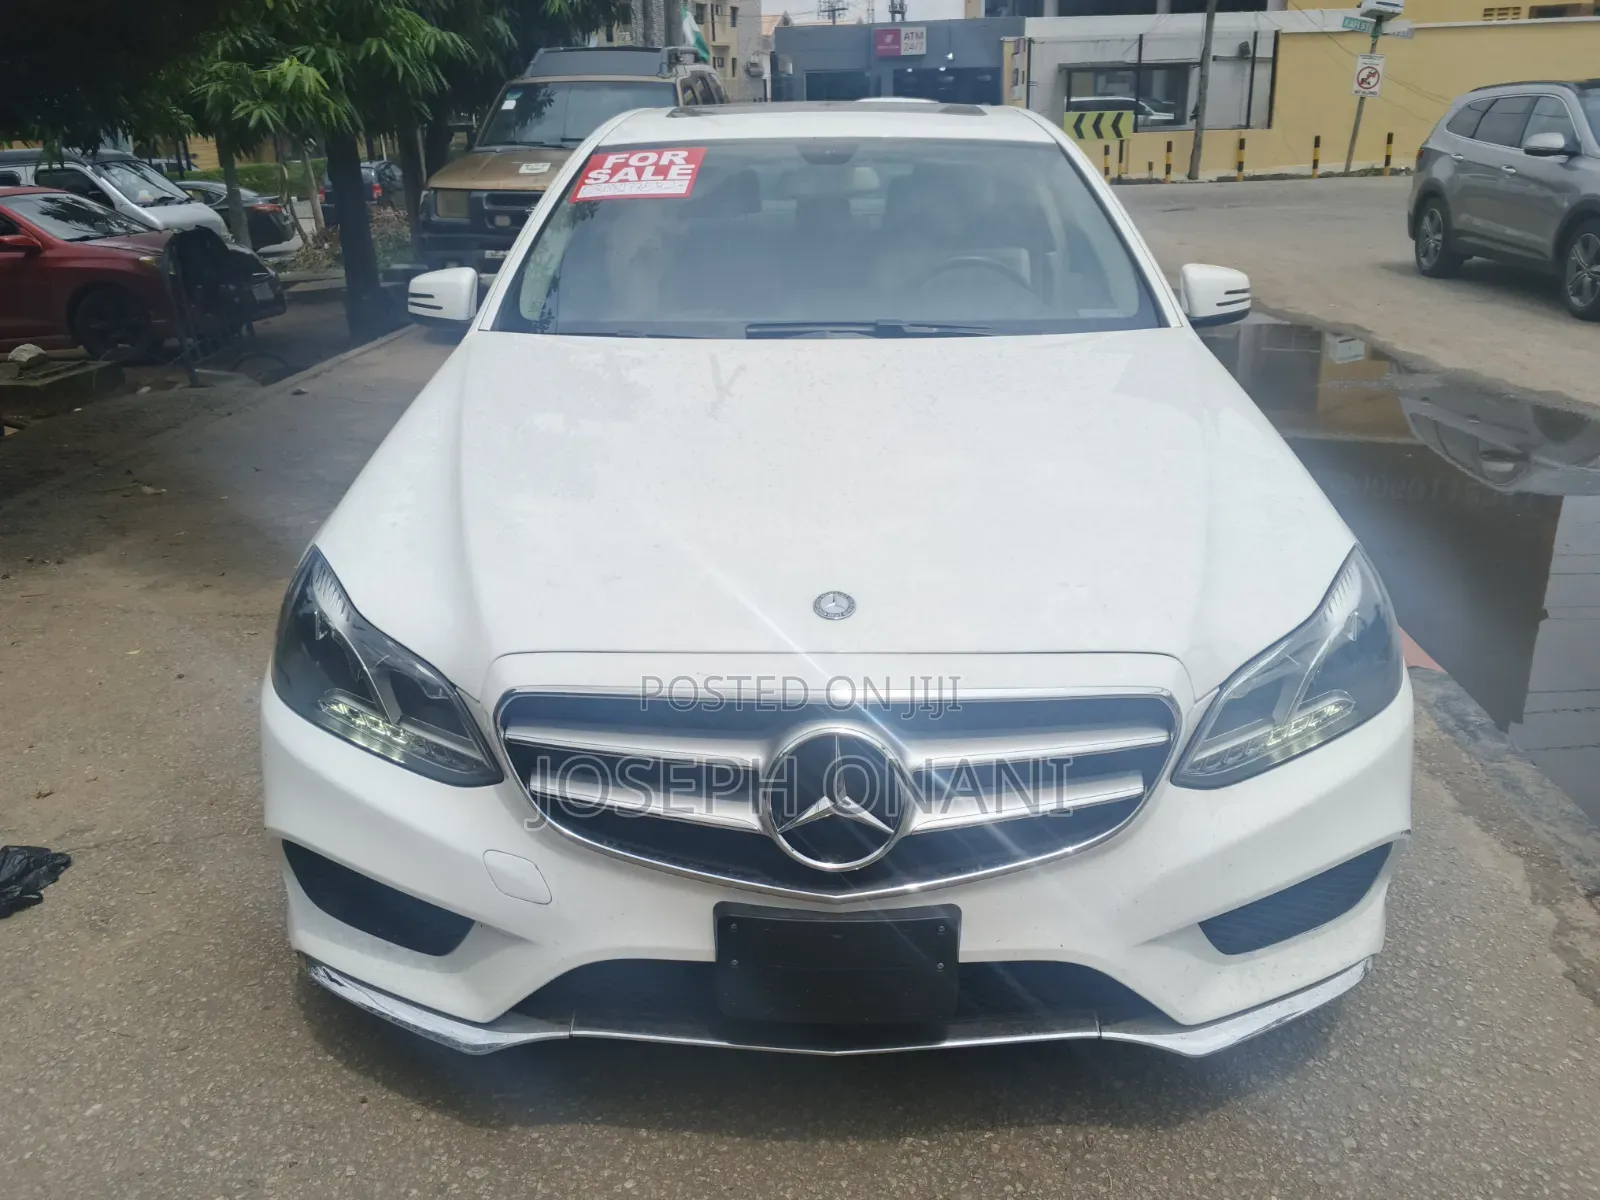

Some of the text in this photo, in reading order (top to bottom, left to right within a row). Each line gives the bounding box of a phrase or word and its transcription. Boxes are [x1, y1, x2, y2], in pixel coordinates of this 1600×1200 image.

[904, 31, 924, 41] ATM
[903, 42, 924, 52] 24/7
[603, 150, 688, 169] FOR
[584, 164, 696, 185] SALE
